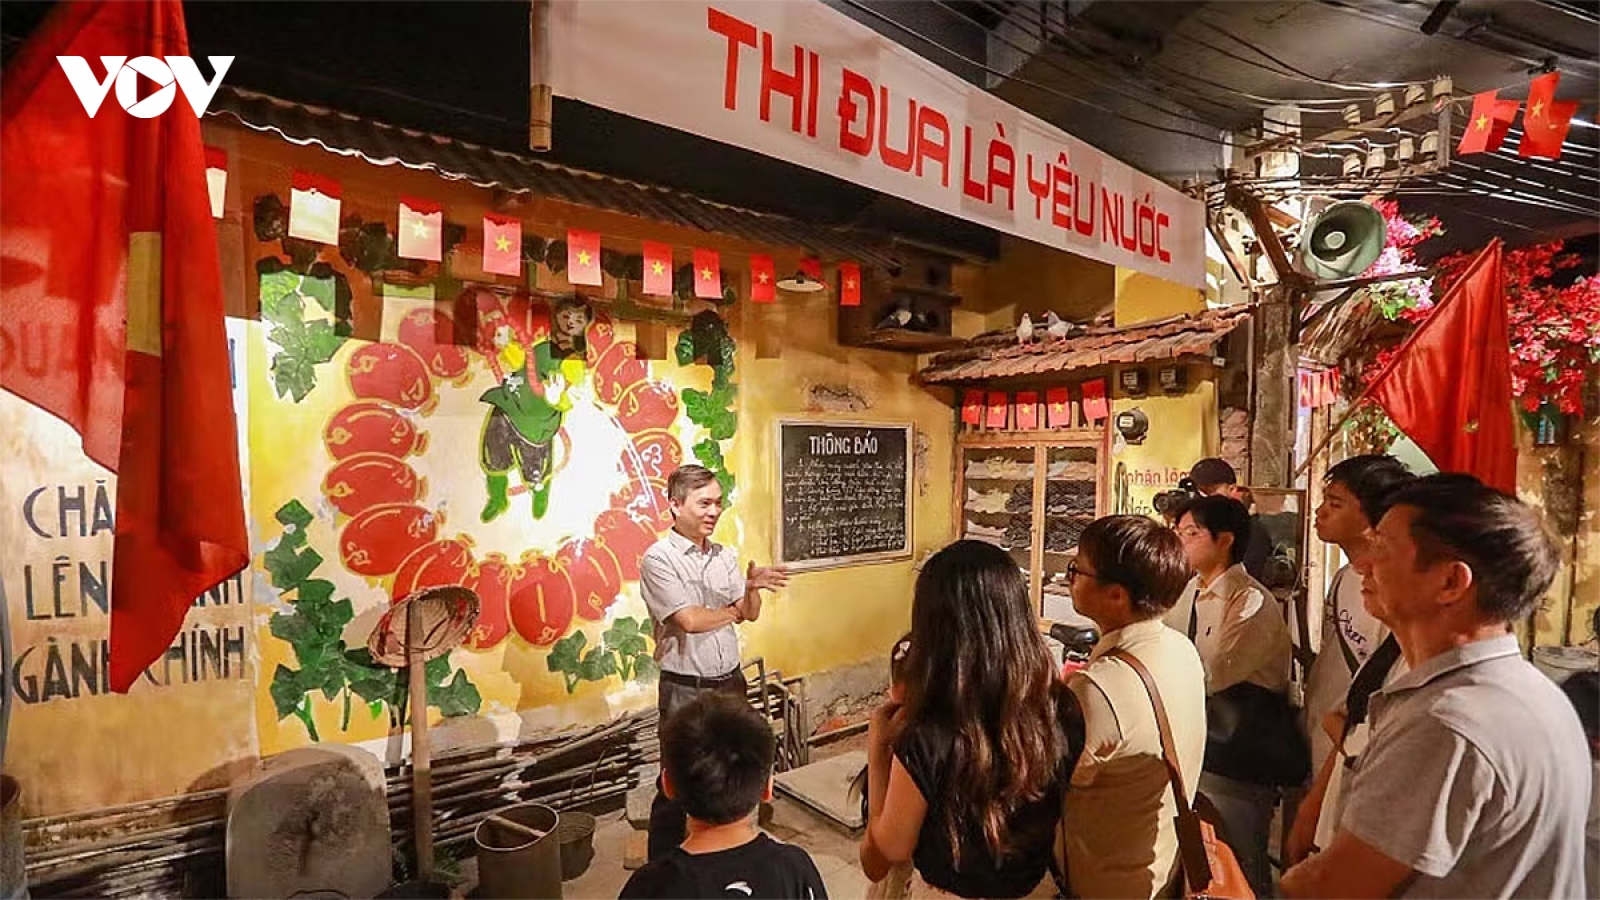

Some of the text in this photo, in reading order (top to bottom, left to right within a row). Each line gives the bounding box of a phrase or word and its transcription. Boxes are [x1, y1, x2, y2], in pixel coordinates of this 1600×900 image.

[707, 7, 819, 138] THI
[838, 67, 951, 188] ĐUA
[963, 123, 1015, 211] LÀ
[1027, 152, 1095, 237] YÊU
[808, 430, 878, 455] THÔNG BÁO
[23, 480, 116, 539] CHĂ
